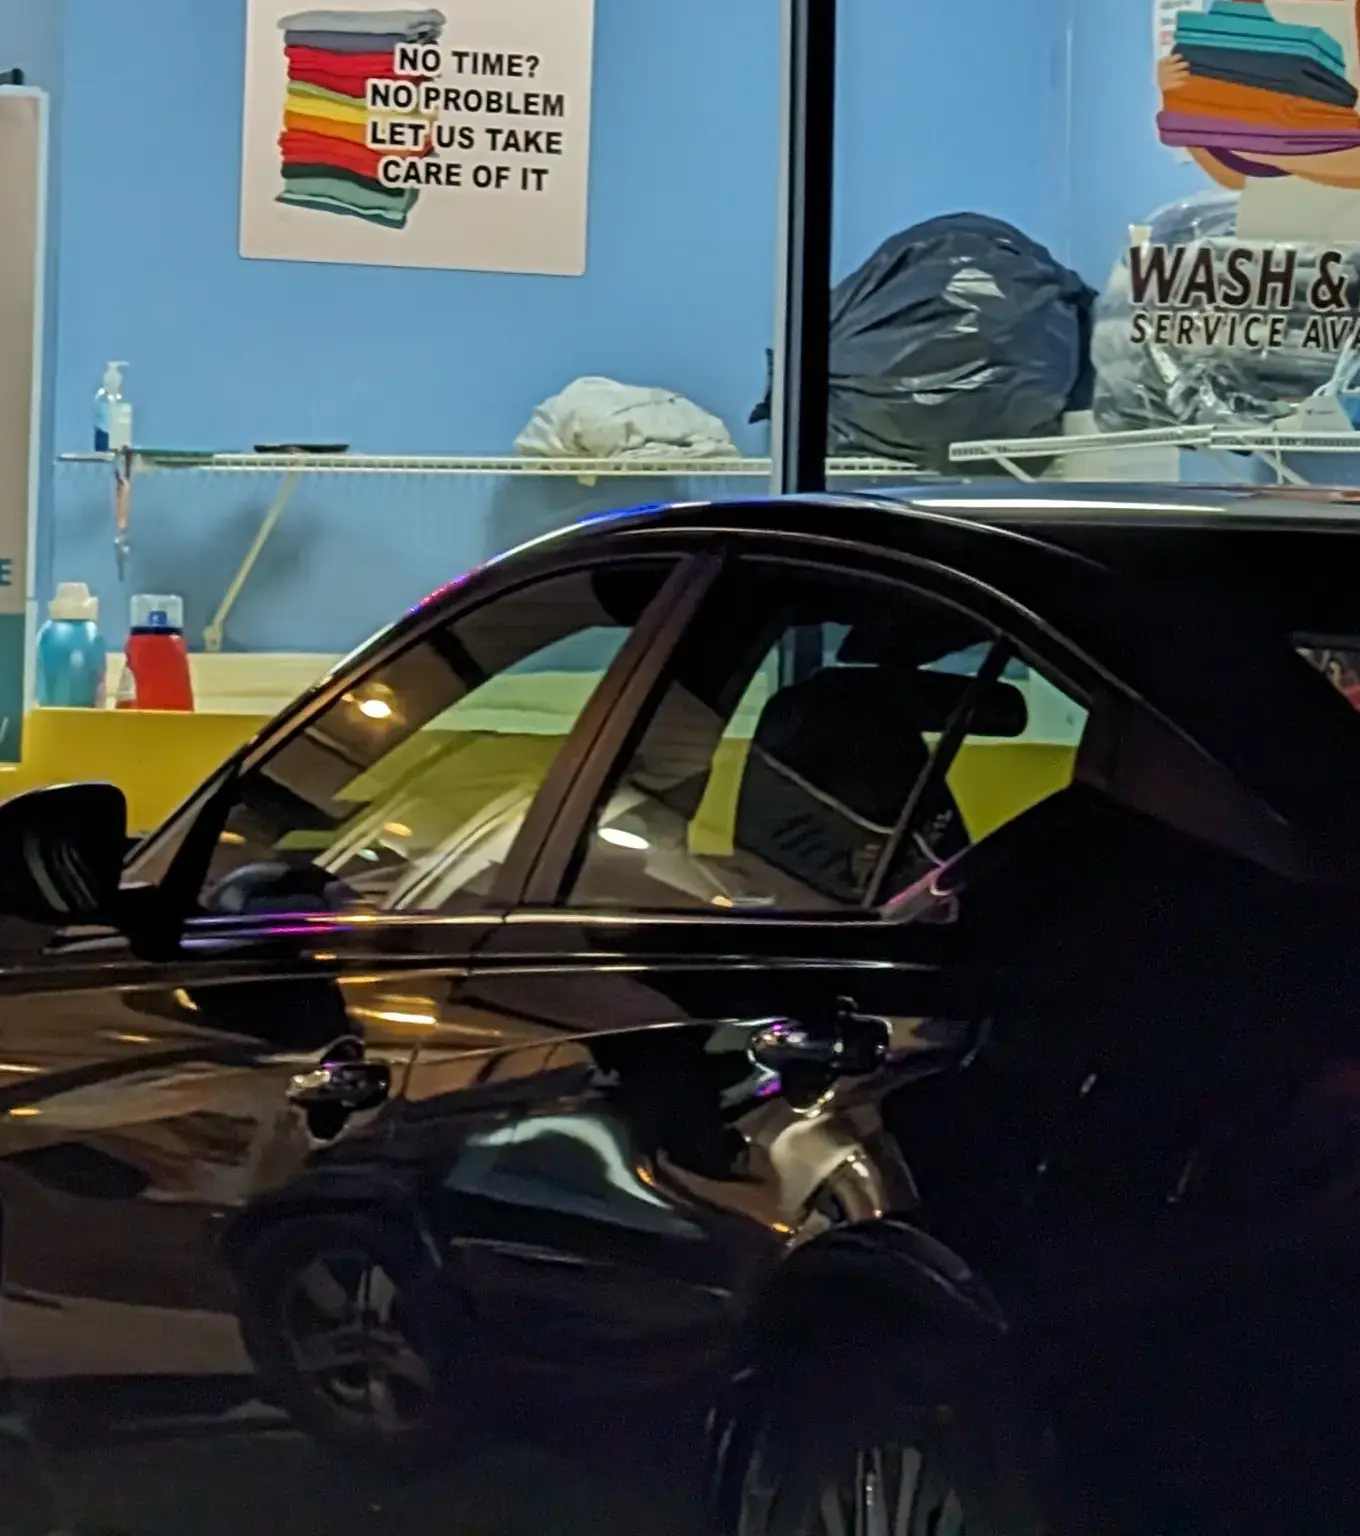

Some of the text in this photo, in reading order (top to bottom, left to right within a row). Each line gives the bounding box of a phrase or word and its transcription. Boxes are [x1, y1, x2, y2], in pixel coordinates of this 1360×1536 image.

[398, 47, 541, 78] NO TIME?
[370, 83, 565, 117] NO PROBLEM
[370, 120, 563, 155] LET US TAKE
[382, 159, 550, 191] CARE OF IT
[1128, 245, 1294, 309] WASH
[1310, 250, 1348, 309] &
[1130, 311, 1285, 348] SERVICE
